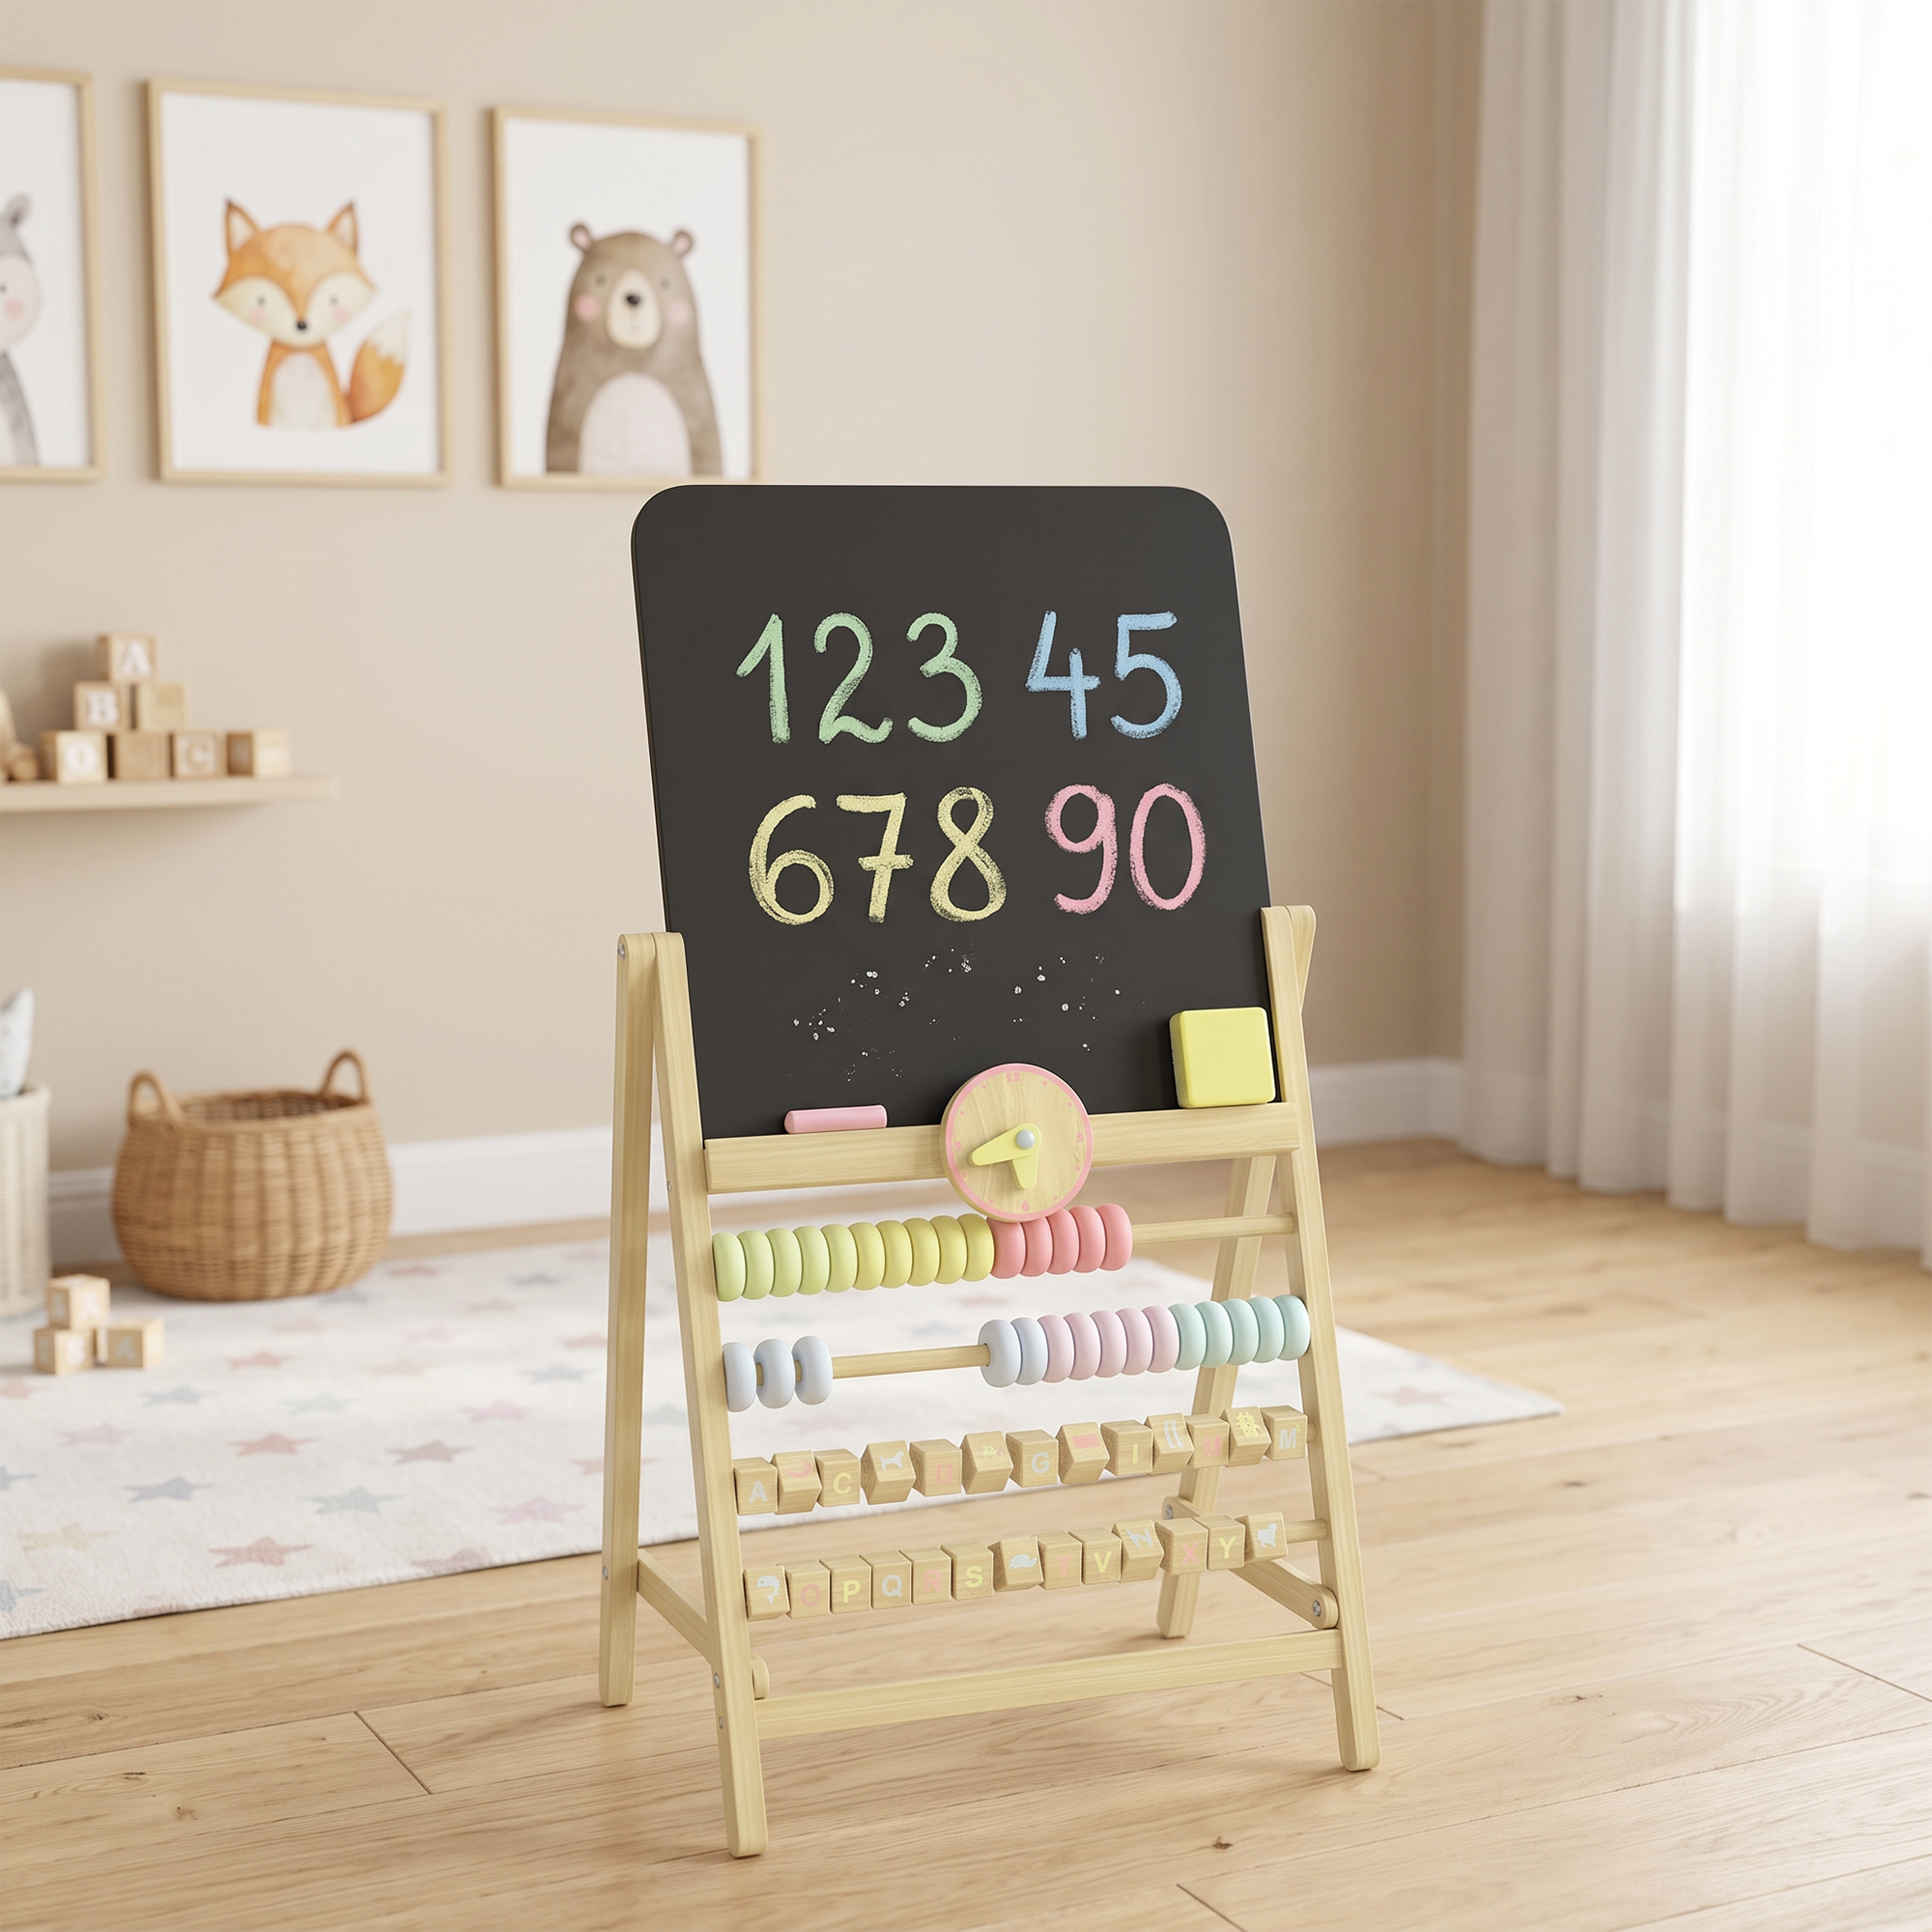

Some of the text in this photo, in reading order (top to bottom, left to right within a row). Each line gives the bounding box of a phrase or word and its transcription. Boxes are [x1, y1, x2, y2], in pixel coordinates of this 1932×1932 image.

[121, 639, 153, 677] A
[85, 689, 119, 726] B
[748, 1481, 769, 1503] A
[833, 1472, 853, 1494] C
[1031, 1451, 1051, 1473] G
[1278, 1428, 1297, 1450] M
[800, 1535, 1236, 1606] O P Q R S T V X Y
